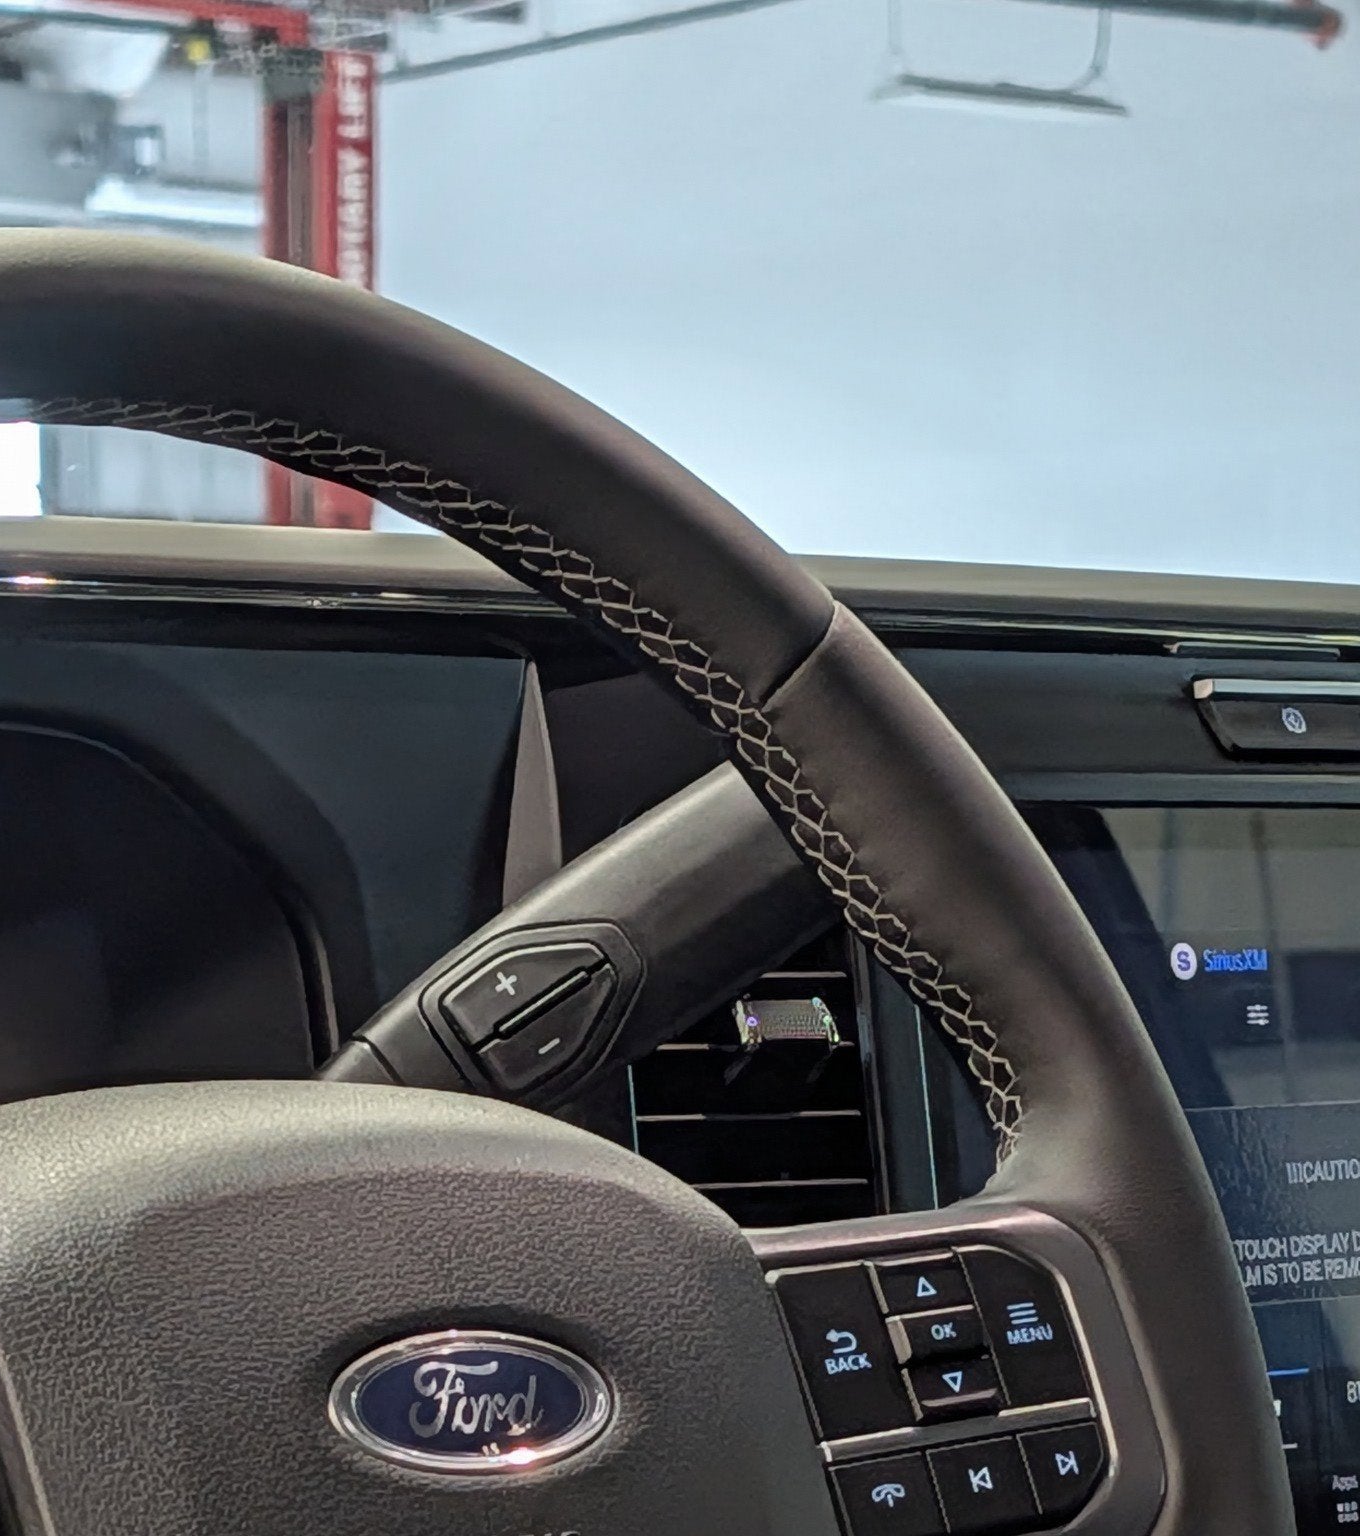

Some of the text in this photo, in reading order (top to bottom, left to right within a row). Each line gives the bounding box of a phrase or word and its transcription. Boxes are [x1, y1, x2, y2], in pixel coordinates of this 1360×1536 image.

[1203, 948, 1268, 972] SiriusXM
[1233, 1236, 1288, 1262] TOUCH
[1290, 1232, 1350, 1258] DISPLAY
[1263, 1263, 1278, 1287] IS
[1277, 1261, 1301, 1284] TO
[1301, 1258, 1324, 1282] BE
[931, 1321, 957, 1341] OK
[1006, 1323, 1053, 1345] MENU
[824, 1352, 872, 1375] BACK
[409, 1361, 545, 1438] Ford
